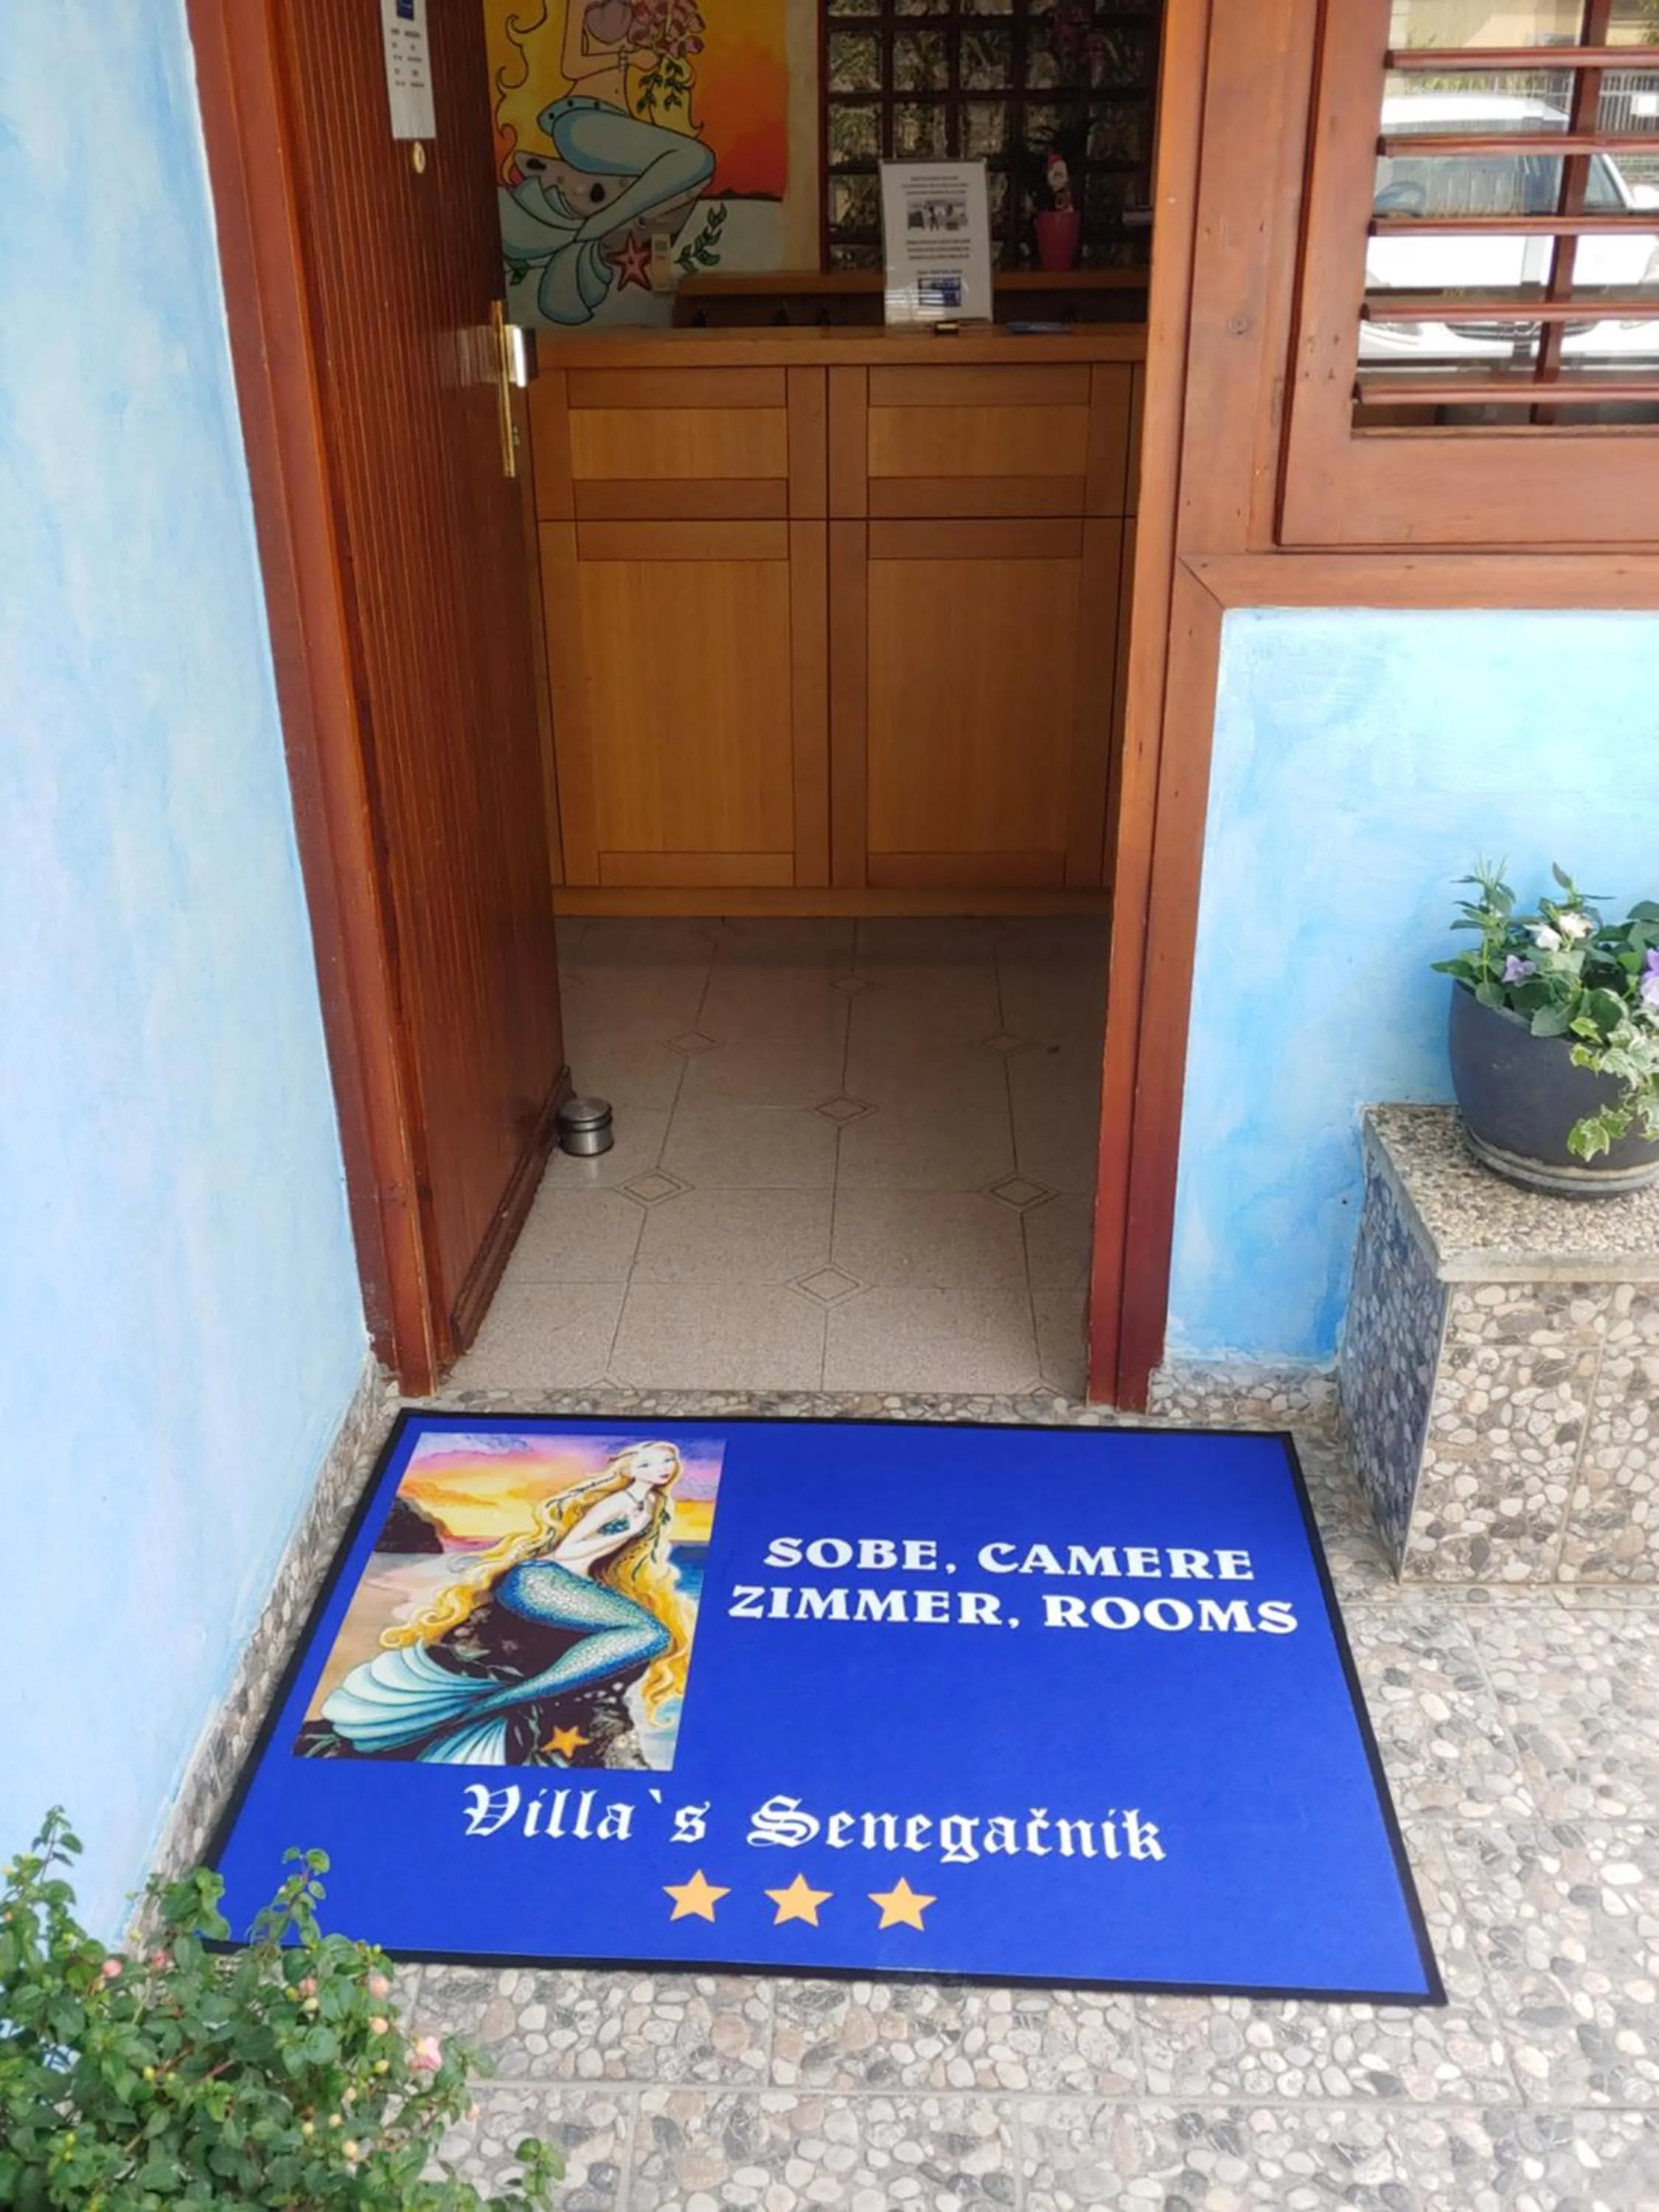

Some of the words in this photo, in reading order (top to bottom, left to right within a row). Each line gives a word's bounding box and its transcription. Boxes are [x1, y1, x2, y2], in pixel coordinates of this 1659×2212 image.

[763, 1537, 957, 1575] SOBE,
[977, 1542, 1255, 1581] CAMERE
[728, 1585, 1020, 1630] ZIMMER,
[1041, 1594, 1298, 1635] ROOMS
[745, 1794, 1167, 1864] Senegačnik
